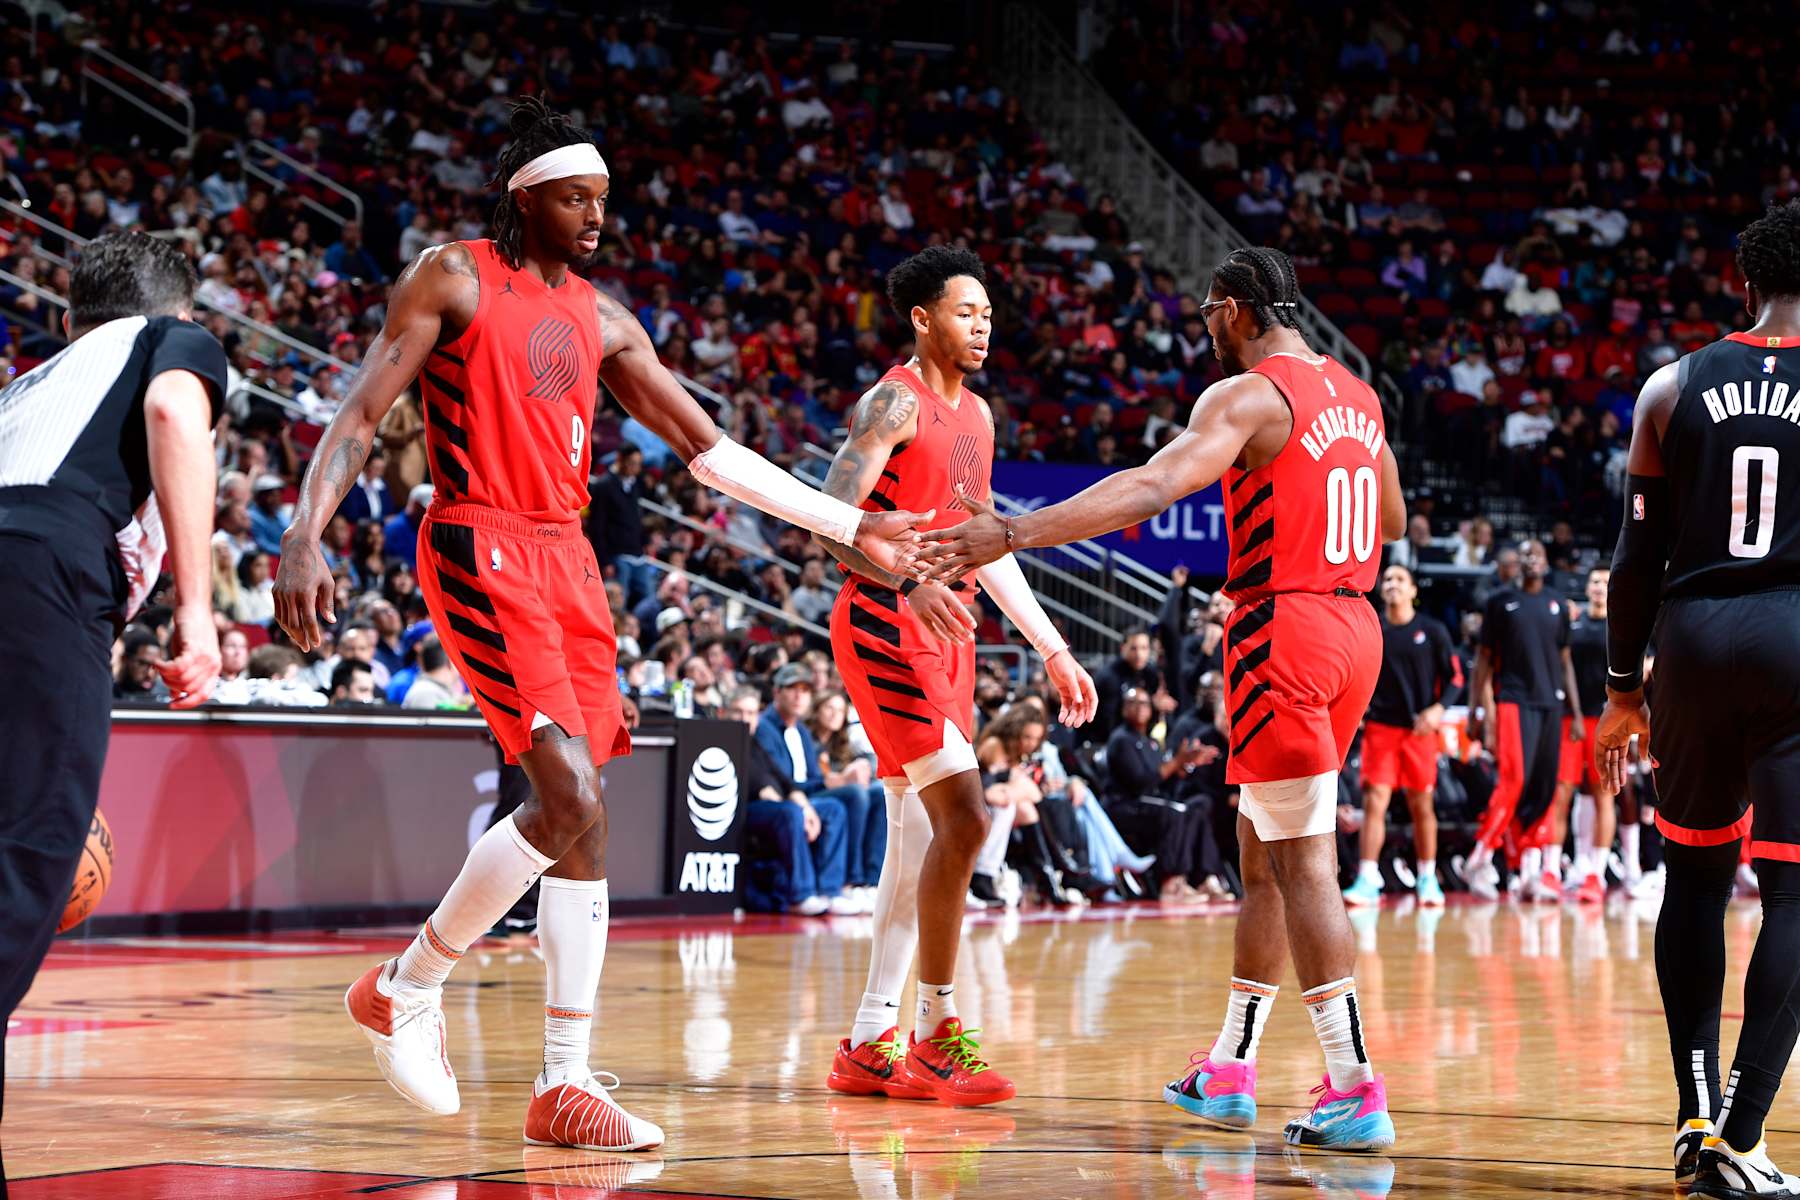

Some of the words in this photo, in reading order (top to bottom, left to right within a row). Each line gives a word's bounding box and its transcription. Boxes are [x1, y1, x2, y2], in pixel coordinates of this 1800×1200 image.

[1701, 380, 1800, 427] HOLIDA
[570, 414, 585, 467] 9
[1300, 405, 1384, 462] HENDERSON
[1150, 502, 1225, 541] ULT
[1324, 465, 1378, 565] 00
[1729, 446, 1779, 558] 0
[679, 851, 741, 893] AT&T
